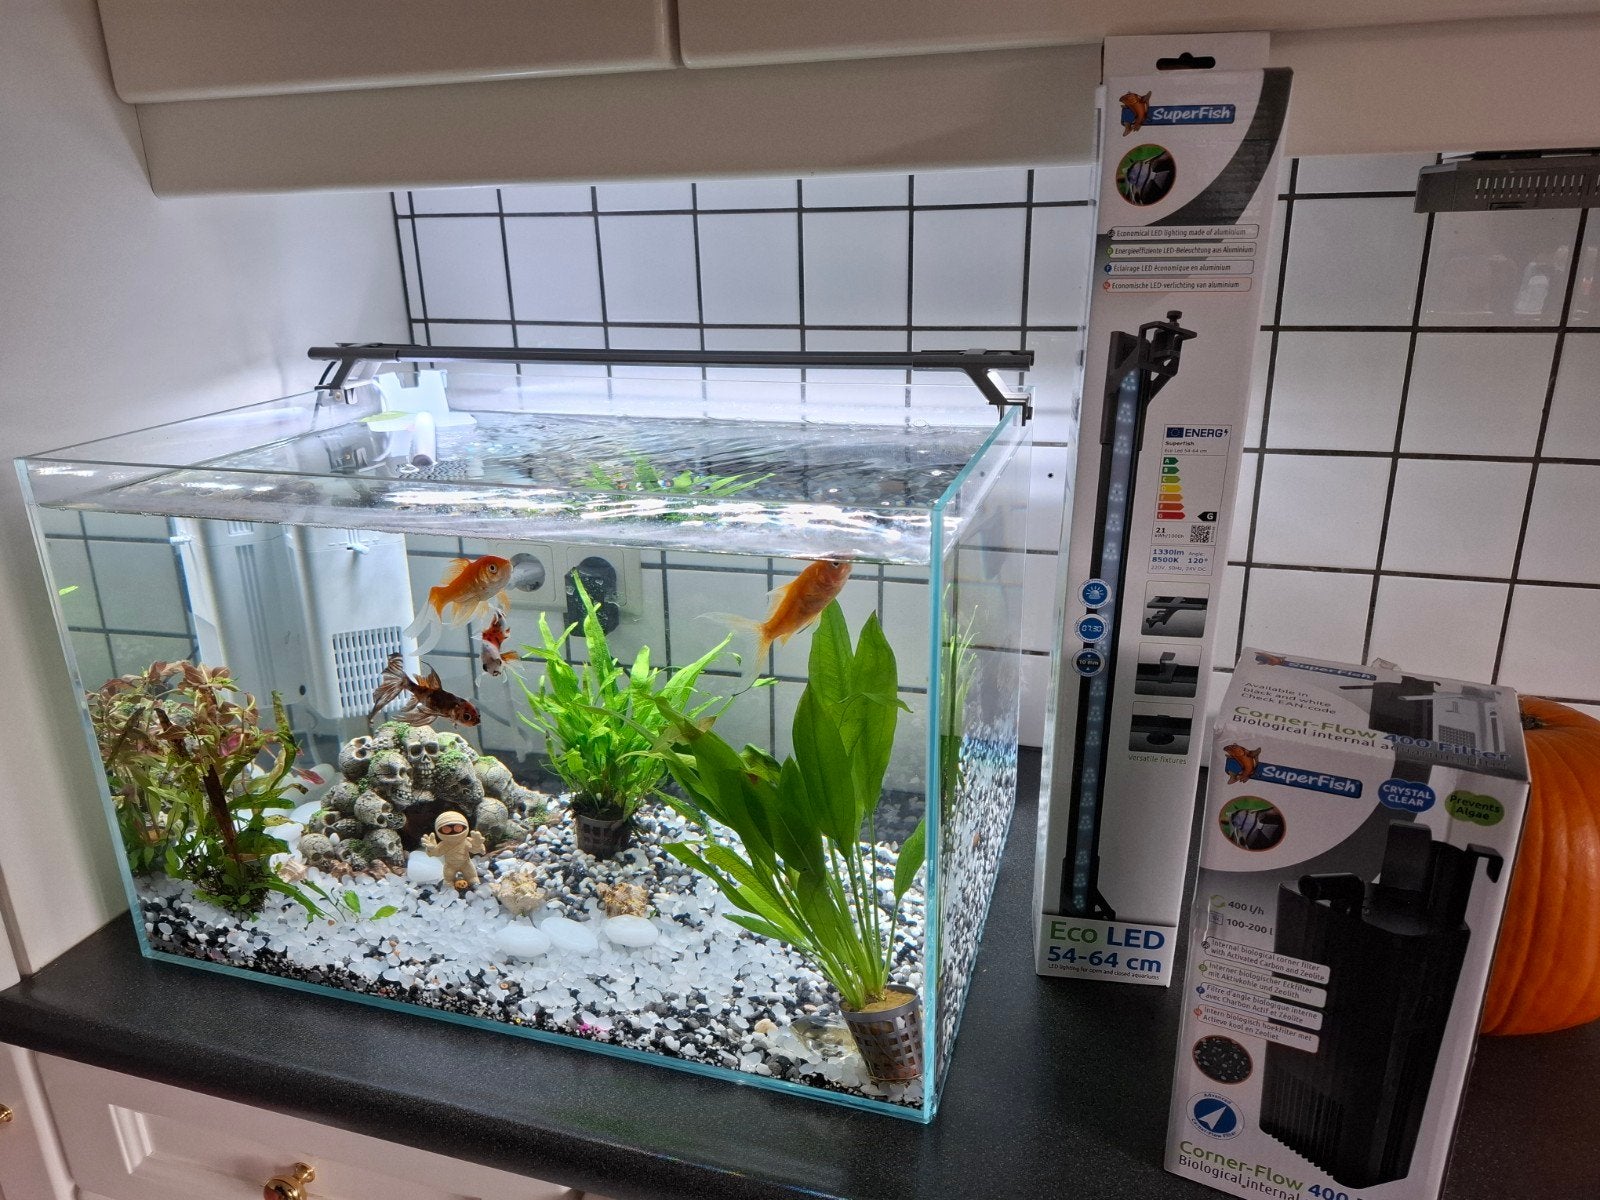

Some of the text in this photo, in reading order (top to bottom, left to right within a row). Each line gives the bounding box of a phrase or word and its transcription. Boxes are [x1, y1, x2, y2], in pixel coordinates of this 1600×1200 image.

[1152, 106, 1231, 123] SuperFish
[1164, 229, 1187, 237] lighting
[1115, 247, 1162, 255] Energieeffiziente
[1163, 246, 1211, 254] LED-Beleuchtung
[1150, 281, 1195, 290] LED-verlichting
[1185, 428, 1223, 438] ENERG
[1287, 661, 1371, 680] SuperFish
[1242, 687, 1332, 708] black and white
[1244, 682, 1295, 695] Available
[1241, 692, 1337, 715] Check EAN-code
[1232, 714, 1307, 736] Biological
[1312, 728, 1375, 748] internal
[1234, 706, 1512, 762] Corner-Flow 400 Filter
[1129, 754, 1187, 765] Versatile fixtures
[1261, 765, 1356, 793] SuperFish
[1382, 784, 1432, 800] CRYSTAL
[1387, 794, 1425, 807] CLEAR
[1450, 794, 1500, 813] Prevents
[1455, 806, 1490, 821] Algae
[1228, 901, 1265, 916] 400 l/h
[1050, 920, 1165, 950] Eco LED
[1226, 918, 1268, 934] 100-200
[1047, 945, 1162, 973] 54-64 cm
[1211, 947, 1325, 981] with Activated Carbon and Zeolite
[1212, 940, 1240, 952] Internal
[1241, 945, 1275, 960] biological
[1276, 954, 1300, 967] corner
[1300, 960, 1320, 971] filter
[1060, 964, 1079, 973] lighting
[1114, 970, 1130, 978] closed
[1131, 972, 1160, 981] aquariums
[1209, 962, 1238, 975] Interner
[1239, 968, 1282, 986] biologischer
[1282, 978, 1313, 994] Eckfilter
[1208, 970, 1300, 999] mit Aktivkohle und Zeolith
[1205, 993, 1220, 1002] avec
[1221, 995, 1251, 1009] Charbon
[1252, 1003, 1269, 1014] Actif
[1270, 1008, 1278, 1016] et
[1206, 985, 1318, 1019] Filtre d'angle biologique interne
[1202, 1014, 1227, 1025] Actieve
[1228, 1021, 1244, 1032] kool
[1254, 1028, 1279, 1040] Zeoliet
[1204, 1006, 1225, 1017] Intern
[1226, 1011, 1261, 1028] biologisch
[1262, 1021, 1297, 1037] hoekfilter
[1298, 1031, 1312, 1042] met
[1179, 1154, 1300, 1200] Biological internal
[1180, 1140, 1350, 1200] Corner-Flow 400
